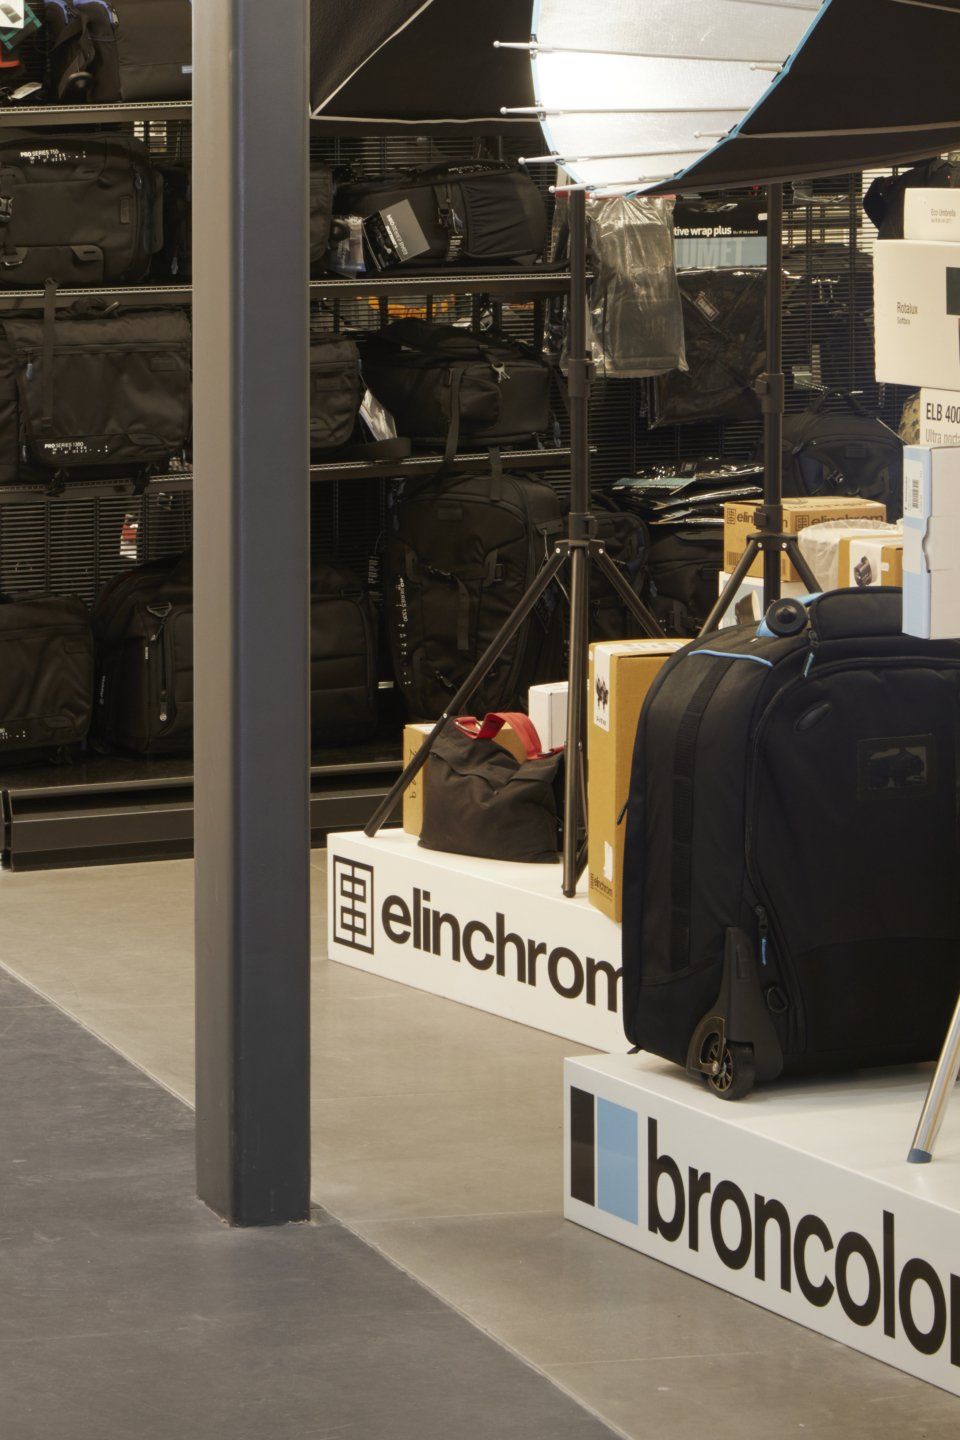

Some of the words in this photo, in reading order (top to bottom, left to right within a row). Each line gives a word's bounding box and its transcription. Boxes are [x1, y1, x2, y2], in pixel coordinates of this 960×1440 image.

[690, 227, 712, 238] wrap
[713, 225, 732, 237] plus
[897, 301, 918, 315] Rotalux
[926, 402, 943, 422] ELB
[925, 427, 942, 445] Ultra
[381, 887, 623, 1013] elinchrom
